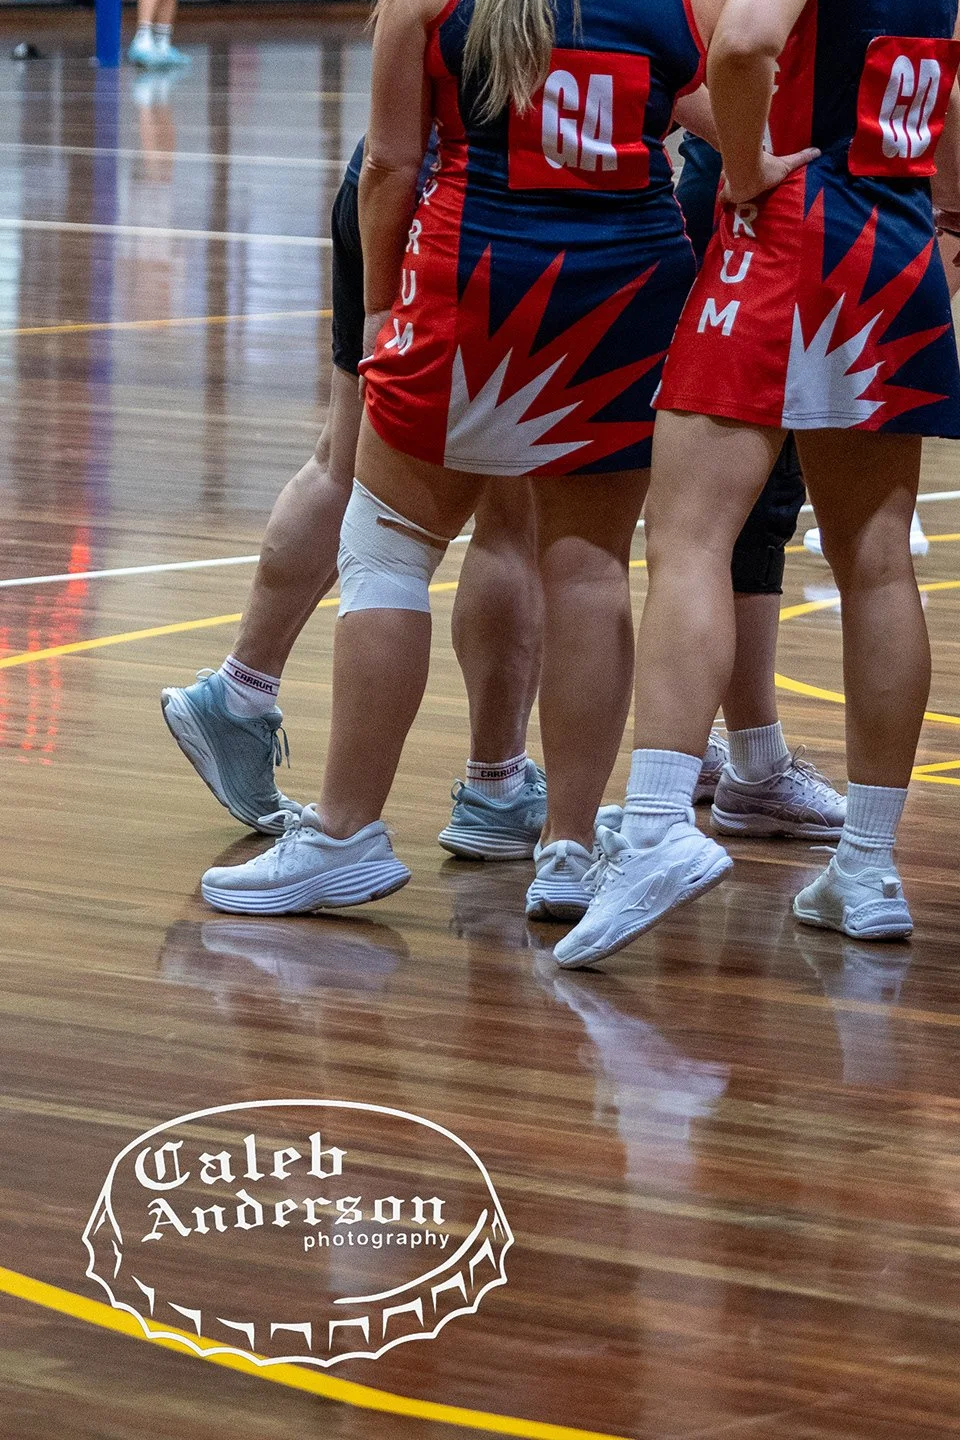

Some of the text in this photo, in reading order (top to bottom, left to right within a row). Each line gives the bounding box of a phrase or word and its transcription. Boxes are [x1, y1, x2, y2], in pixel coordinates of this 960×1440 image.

[541, 69, 618, 172] GA
[878, 54, 941, 159] GD
[233, 669, 274, 693] CARRUM
[480, 764, 519, 779] CARRUM
